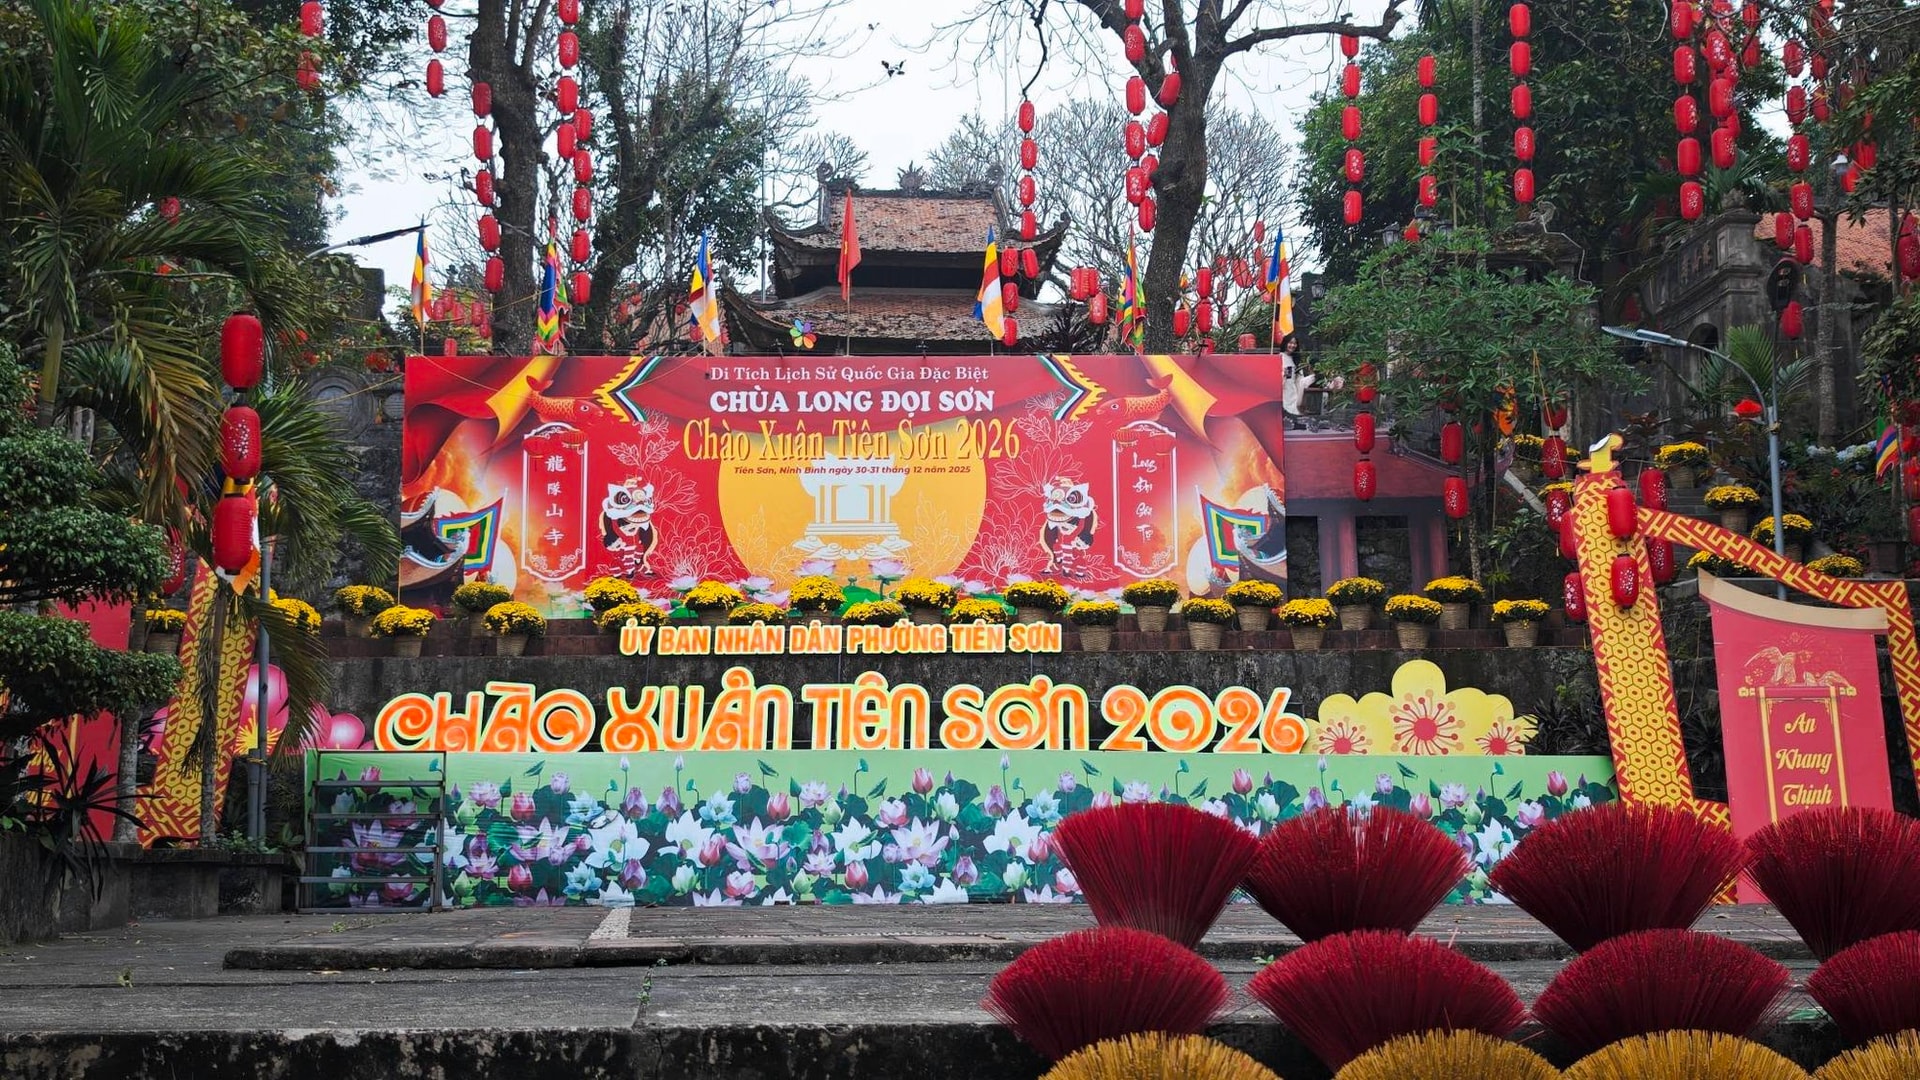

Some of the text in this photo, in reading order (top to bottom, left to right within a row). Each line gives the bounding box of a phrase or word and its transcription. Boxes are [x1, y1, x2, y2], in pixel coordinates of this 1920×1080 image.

[711, 364, 989, 383] Di Tích Lịch Sử Quốc Gia Đặc Biệt
[709, 384, 995, 418] CHÙA LONG ĐỌI SƠN
[683, 417, 1020, 461] Chào Xuân Tiên Sơn 2026
[779, 466, 801, 475] Ninh
[828, 466, 854, 476] ngày
[855, 466, 880, 475] 30-31
[881, 465, 911, 476] tháng
[913, 466, 922, 474] 12
[948, 466, 971, 474] 2025
[620, 617, 1062, 656] ỦY BAN NHÂN DÂN PHƯỜNG TIÊN SƠN
[1100, 684, 1310, 754] 2026
[1784, 711, 1817, 734] An
[1775, 748, 1833, 775] Khang
[1782, 783, 1834, 811] Thịnh
